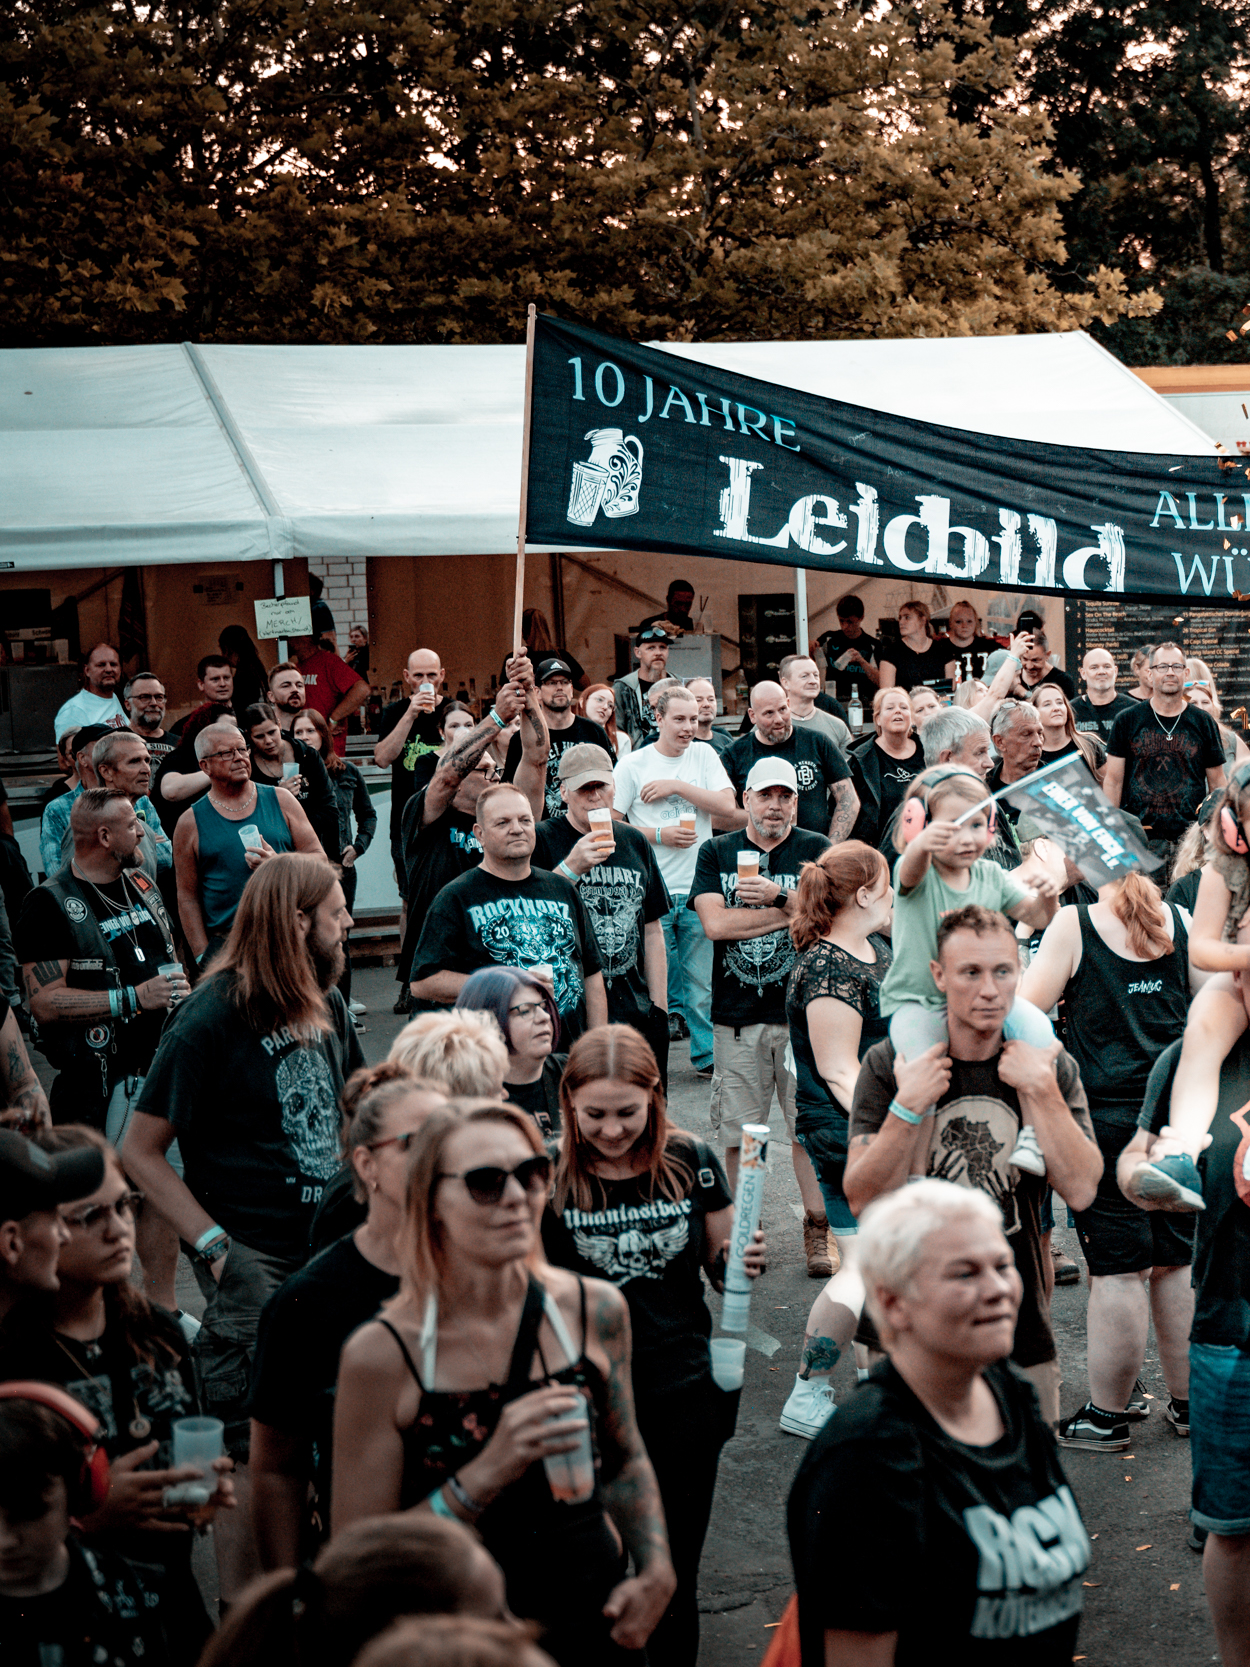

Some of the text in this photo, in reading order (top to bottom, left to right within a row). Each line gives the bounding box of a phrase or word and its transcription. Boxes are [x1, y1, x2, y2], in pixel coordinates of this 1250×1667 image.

[567, 356, 801, 452] 10 JAHRE
[713, 455, 1126, 592] Leidbild
[302, 674, 318, 685] AK
[494, 926, 510, 940] 20
[551, 923, 565, 937] 24
[736, 1174, 756, 1259] GOLDREGEN
